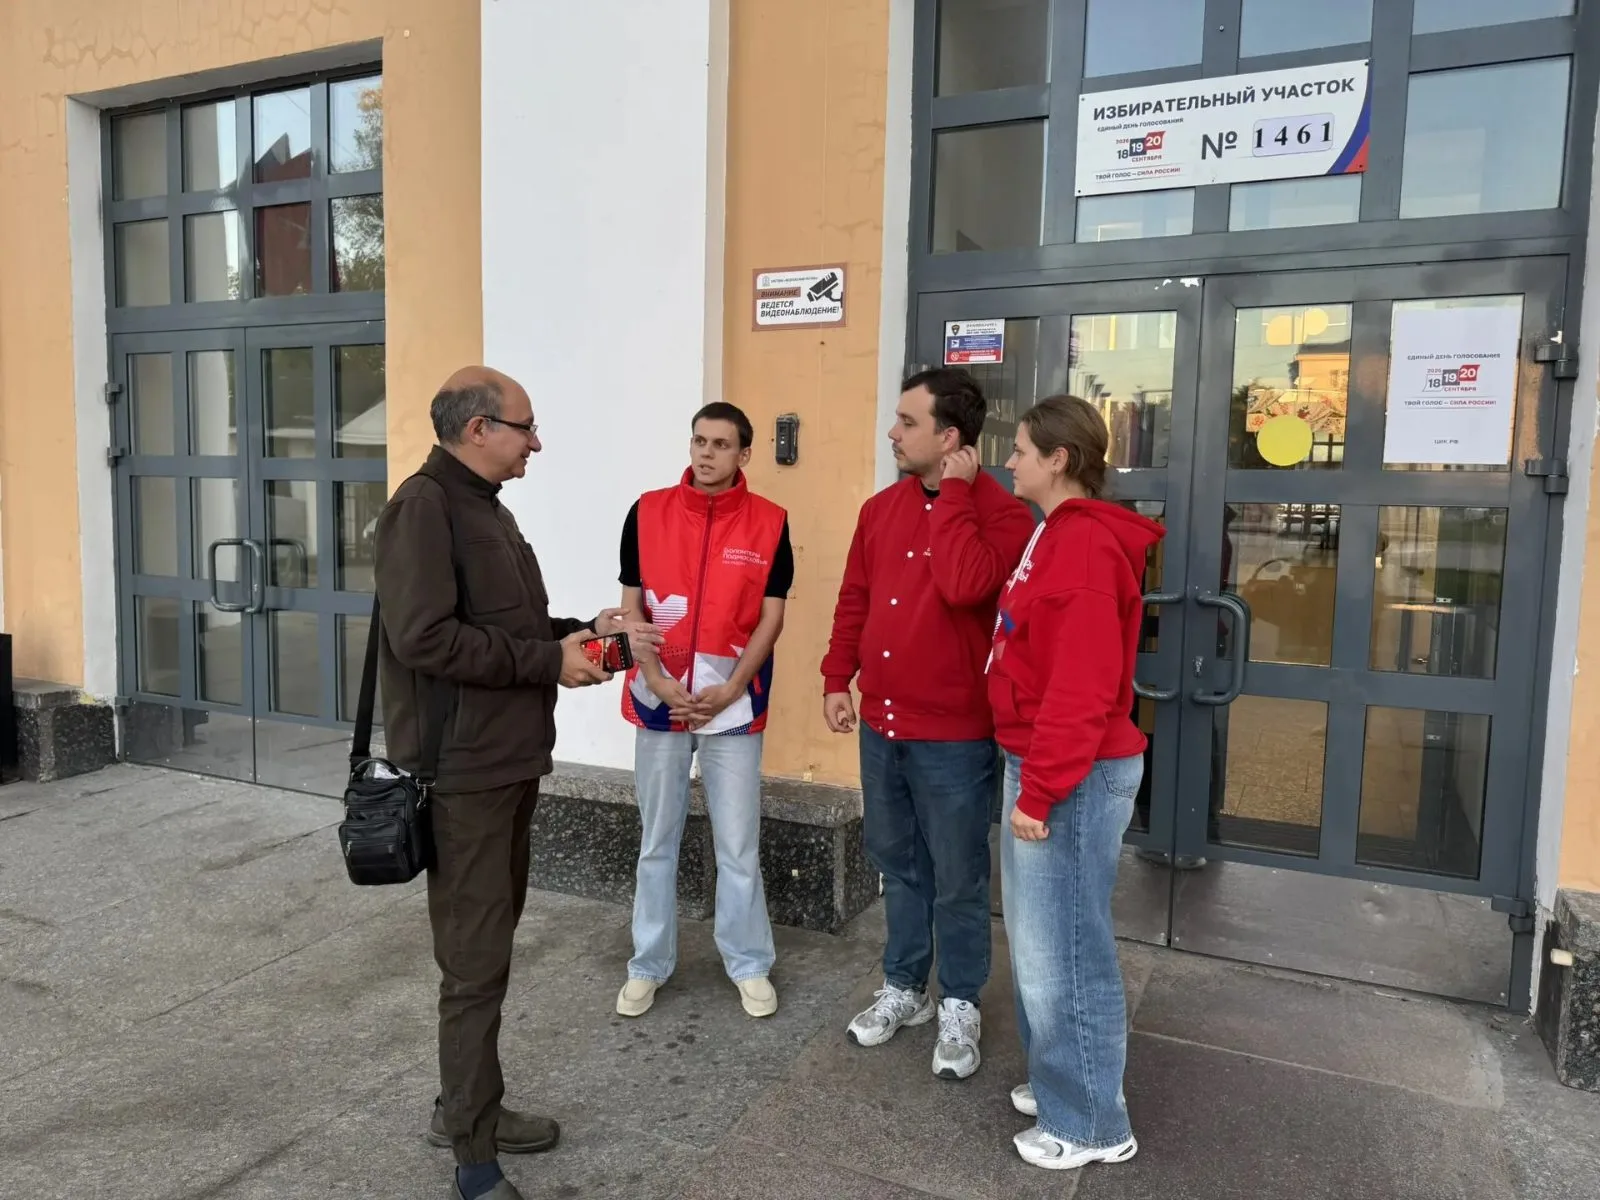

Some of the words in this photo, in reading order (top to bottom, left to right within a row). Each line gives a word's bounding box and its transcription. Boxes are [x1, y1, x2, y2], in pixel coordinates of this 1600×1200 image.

[1093, 86, 1255, 120] ИЗБИРАТЕЛЬНЫЙ
[1262, 78, 1355, 102] УЧАСТОК
[1097, 124, 1122, 132] ЕДИНЫЙ
[1139, 118, 1184, 127] ГОЛОСОВАНИЯ
[1117, 149, 1129, 159] 18
[1131, 142, 1143, 153] 19
[1146, 136, 1161, 146] 20
[1201, 131, 1238, 160] №
[1254, 121, 1333, 149] 1461
[761, 289, 798, 298] ВНИМАНИЕ
[760, 300, 794, 309] ВЕДЕТСЯ
[760, 306, 840, 318] ВИДЕОНАБЛЮДЕНИЕ!
[1428, 378, 1441, 388] 18
[1444, 373, 1457, 383] 19
[1459, 367, 1476, 378] 20
